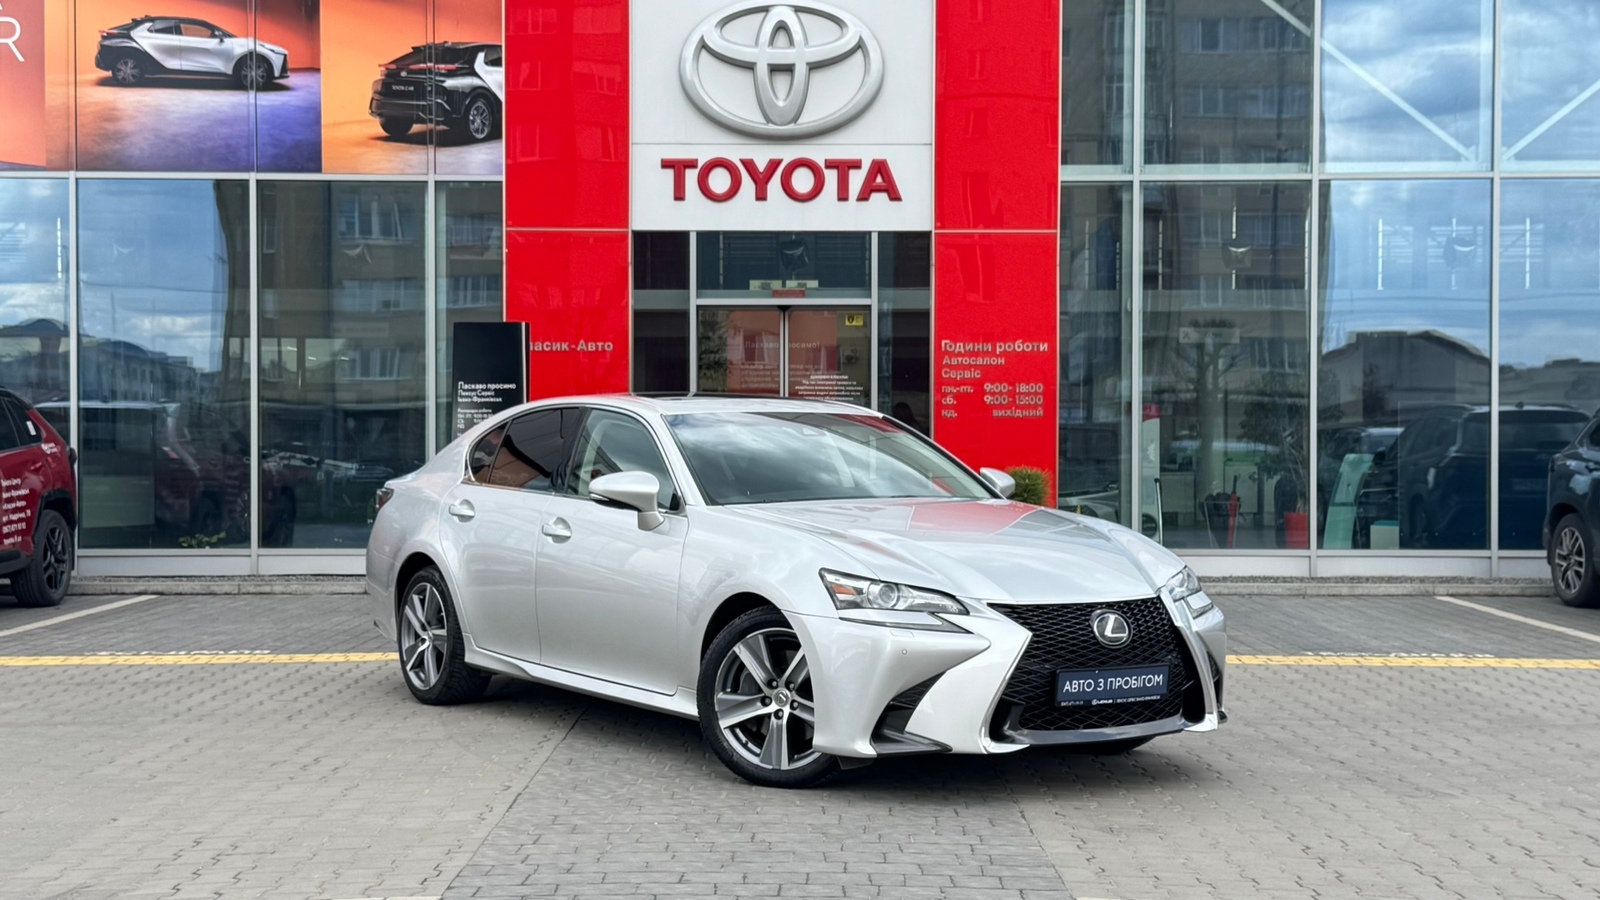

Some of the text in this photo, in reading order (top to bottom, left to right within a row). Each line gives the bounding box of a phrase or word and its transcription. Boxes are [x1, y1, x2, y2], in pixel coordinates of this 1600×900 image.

[661, 157, 903, 203] TOYOTA
[941, 339, 1049, 355] Години роботи
[942, 355, 1005, 365] Автосалон
[941, 367, 981, 380] Сервіс
[458, 381, 517, 391] Ласкаво просимо
[477, 389, 495, 397] Сервіс
[941, 394, 957, 405] сб.
[941, 406, 1044, 418] нд. вихідний
[1063, 680, 1095, 693] АВТО
[1107, 674, 1163, 690] ПРОБІГОМ
